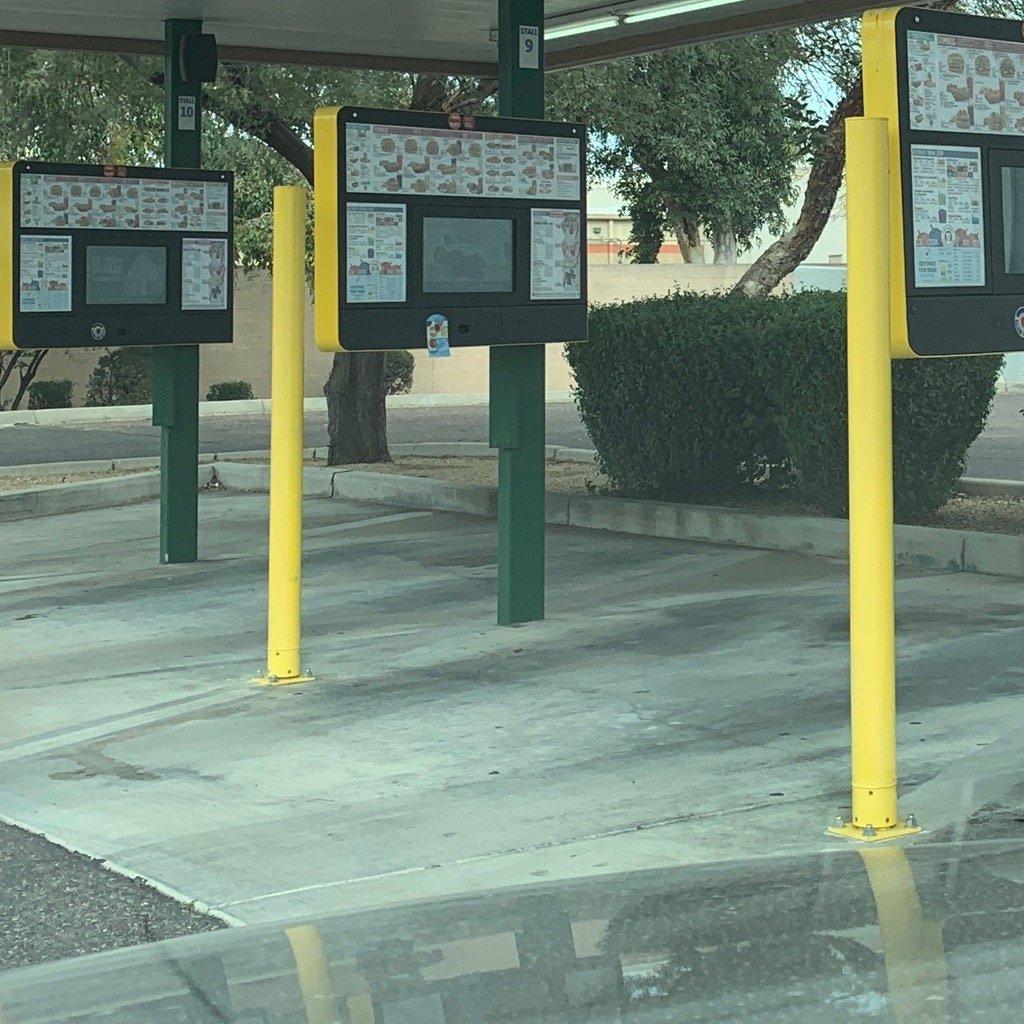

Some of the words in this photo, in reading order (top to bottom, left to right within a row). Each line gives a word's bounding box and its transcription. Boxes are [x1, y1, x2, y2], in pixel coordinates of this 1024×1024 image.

[520, 27, 538, 36] STALL
[525, 38, 534, 53] 9
[180, 106, 194, 118] 10
